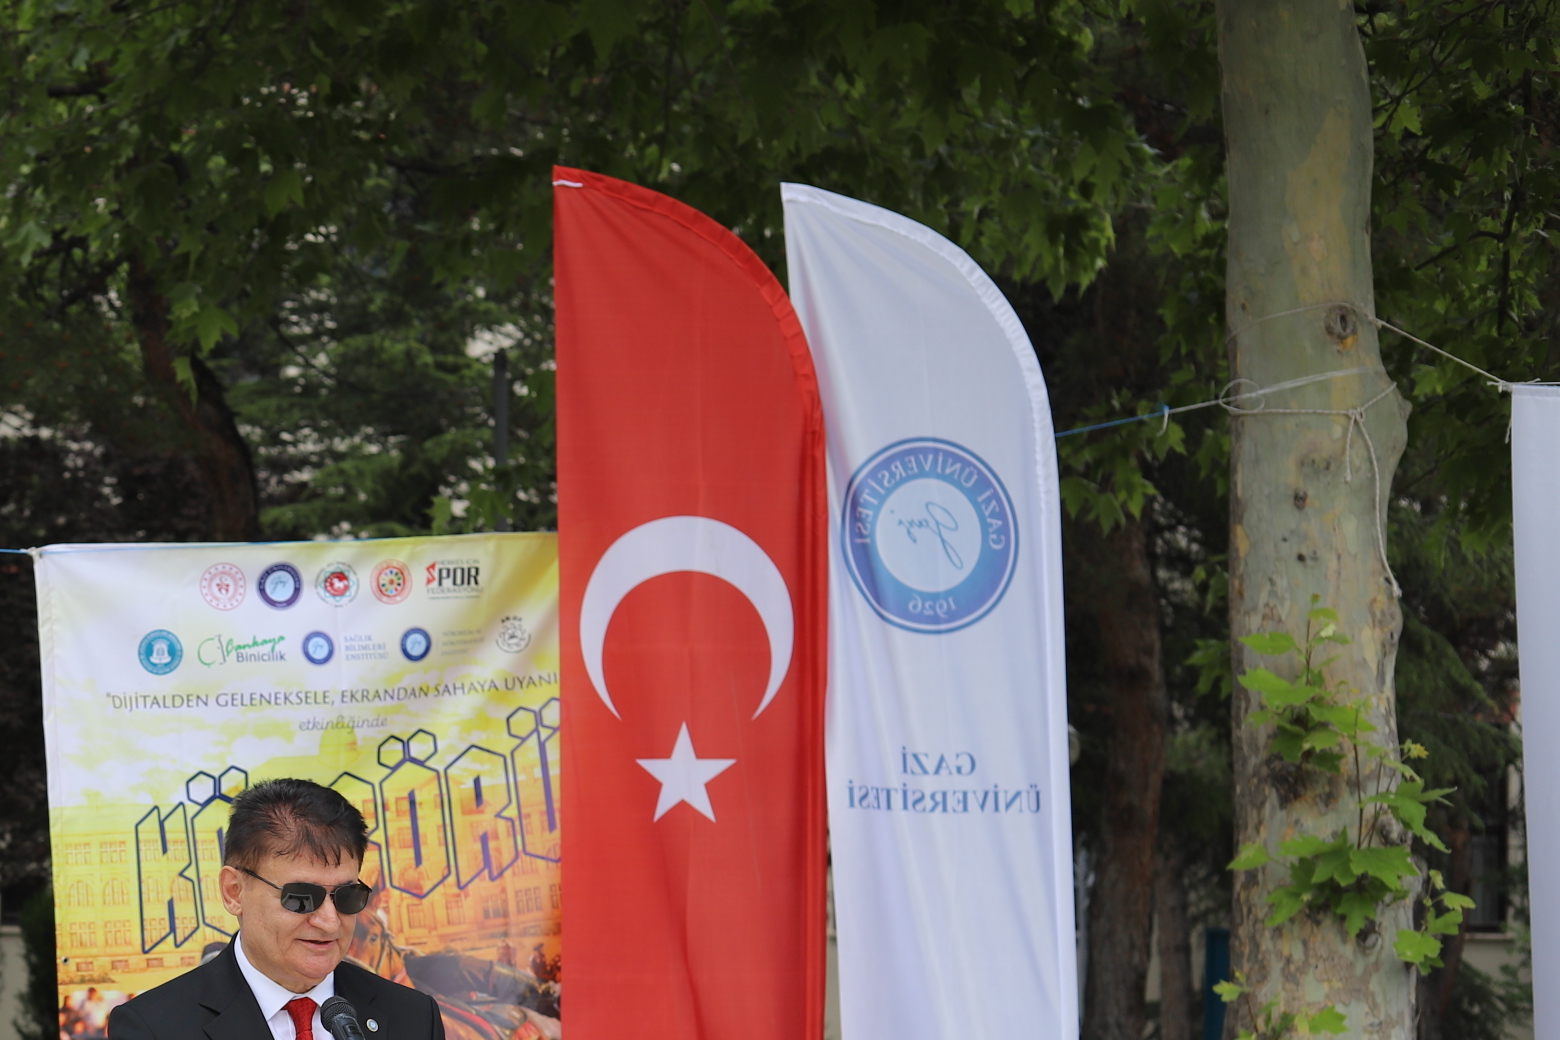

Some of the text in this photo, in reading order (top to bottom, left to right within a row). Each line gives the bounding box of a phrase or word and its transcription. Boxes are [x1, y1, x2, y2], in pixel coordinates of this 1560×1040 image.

[425, 560, 480, 587] SPOR
[236, 651, 287, 664] Binicilik
[215, 690, 335, 708] GELENEKSELE,
[341, 686, 430, 704] EKRANDAN
[434, 679, 500, 698] SAHAYA
[504, 672, 559, 692] UYANI
[299, 714, 388, 735] etkinliğinde
